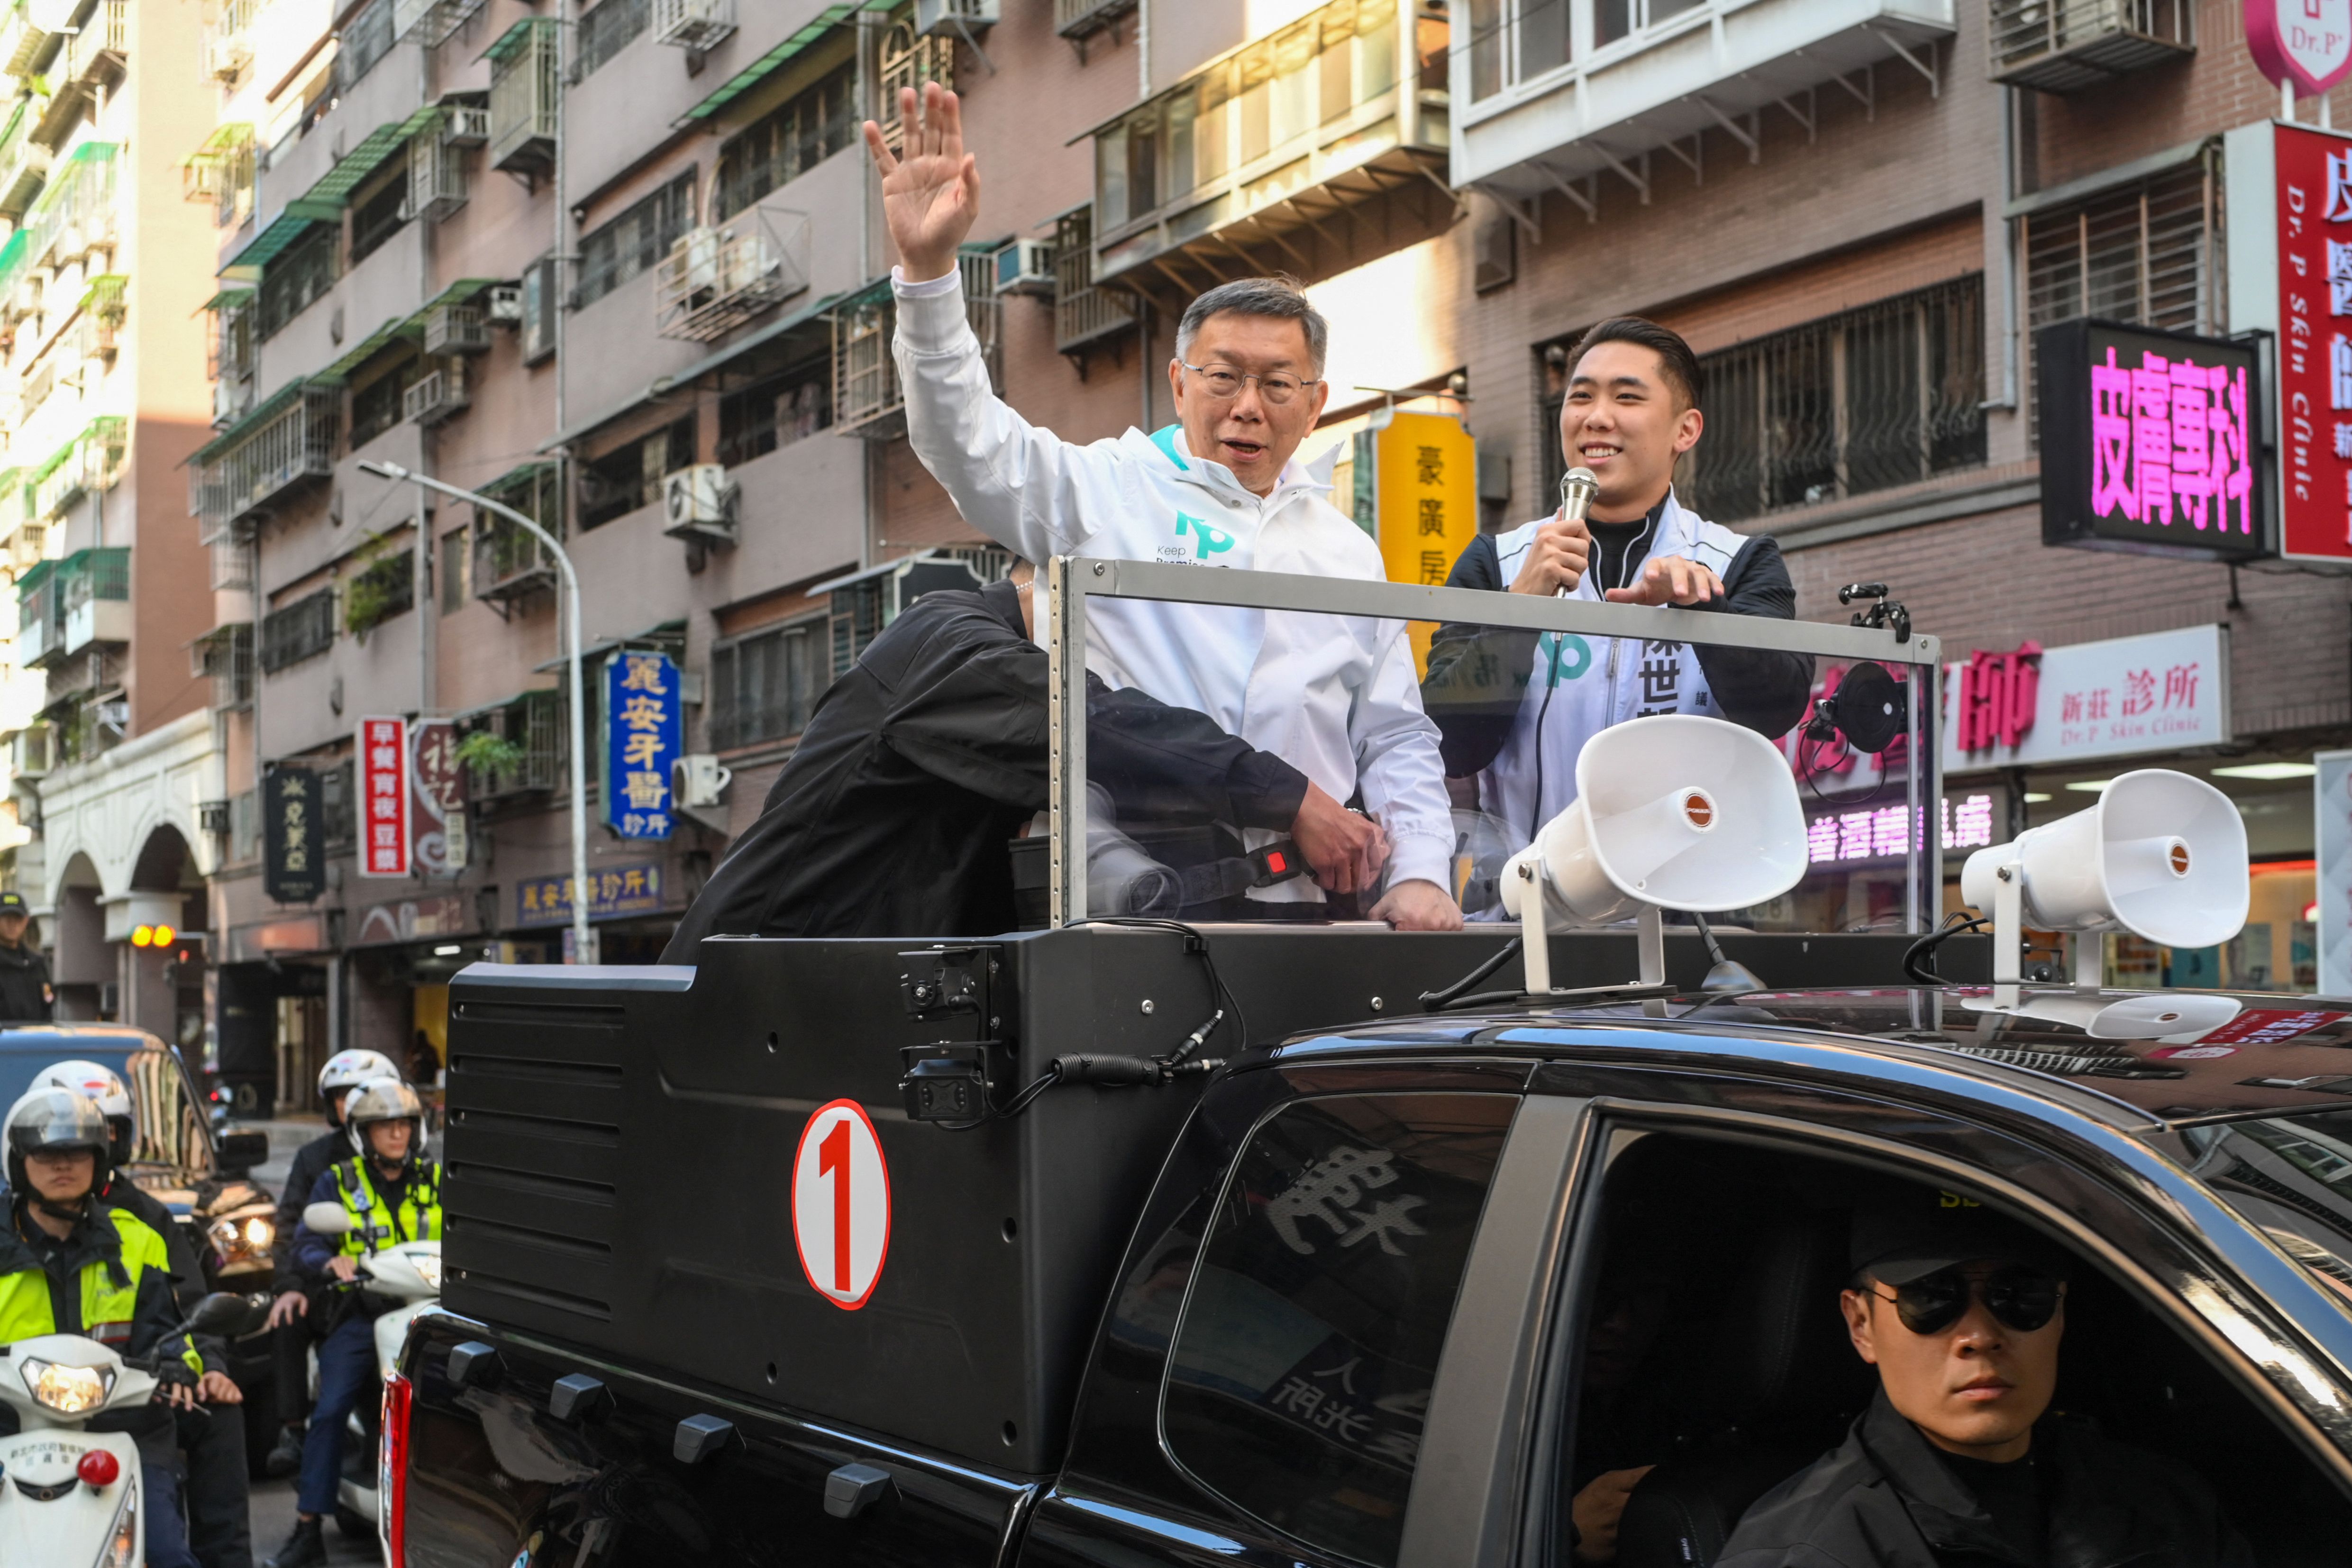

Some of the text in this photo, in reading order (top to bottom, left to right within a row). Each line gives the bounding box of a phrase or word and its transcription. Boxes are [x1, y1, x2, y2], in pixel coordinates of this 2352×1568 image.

[2289, 252, 2306, 277] P
[2091, 346, 2252, 535] 皮膚專科
[2292, 392, 2313, 501] Clinic
[1157, 546, 1186, 558] Keep
[2121, 662, 2198, 717] 診所
[2152, 712, 2202, 735] Clinic
[620, 656, 670, 809] 麗安牙醫
[371, 721, 398, 872] 早餐宵夜豆漿
[622, 812, 670, 837] 診所
[819, 1120, 851, 1292] 1
